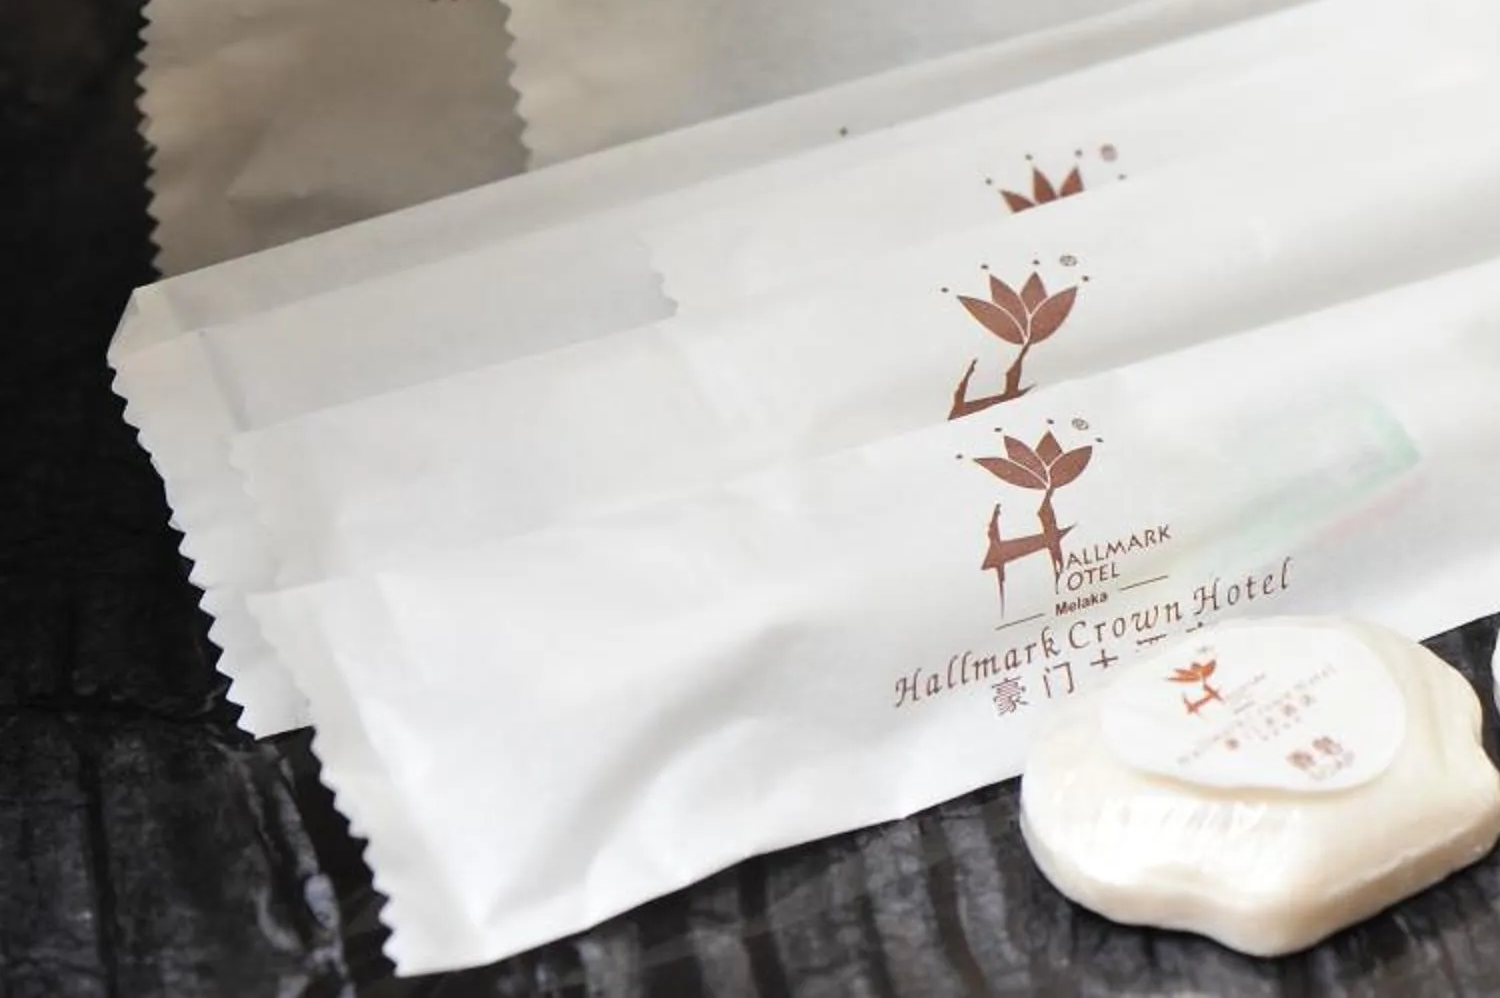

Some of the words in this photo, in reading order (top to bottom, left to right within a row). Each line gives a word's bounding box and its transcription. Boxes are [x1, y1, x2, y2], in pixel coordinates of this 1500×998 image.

[894, 625, 1062, 709] Hallmark
[1068, 601, 1184, 651] Crown
[1192, 555, 1294, 616] Hotel
[1054, 590, 1109, 617] Melaka
